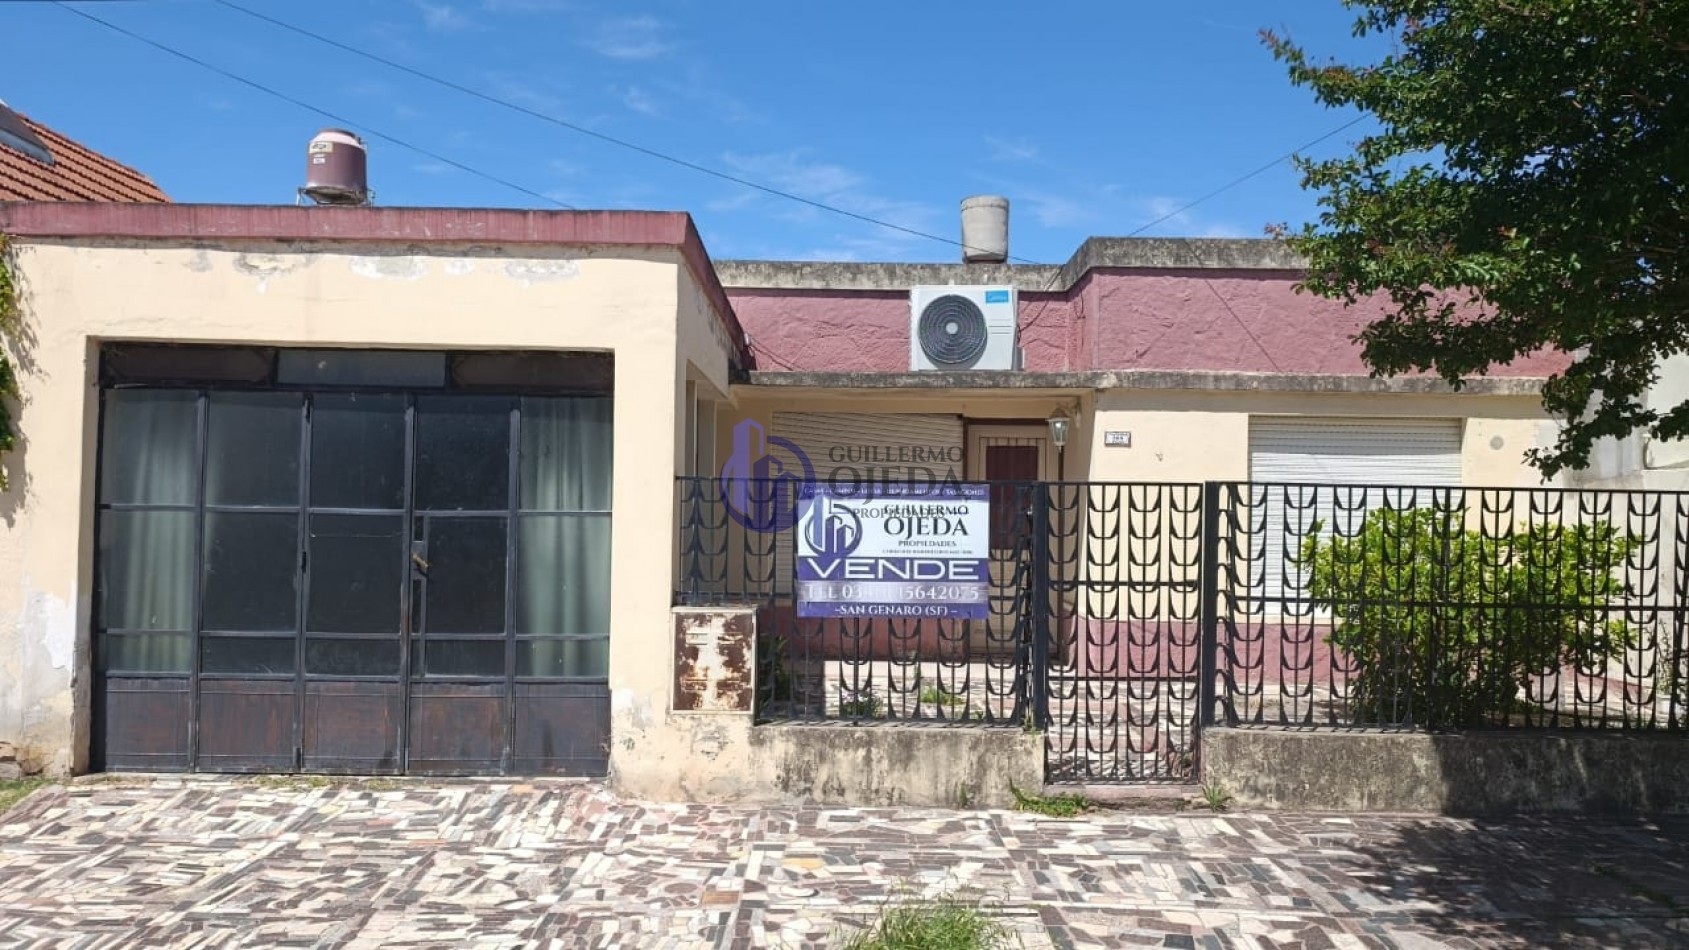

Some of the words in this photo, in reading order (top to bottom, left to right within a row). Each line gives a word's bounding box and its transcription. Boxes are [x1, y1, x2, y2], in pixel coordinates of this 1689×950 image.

[883, 517, 969, 539] OJEDA
[898, 540, 957, 548] PROPIEDADES
[807, 558, 979, 580] VENDE
[868, 605, 922, 616] GENARO
